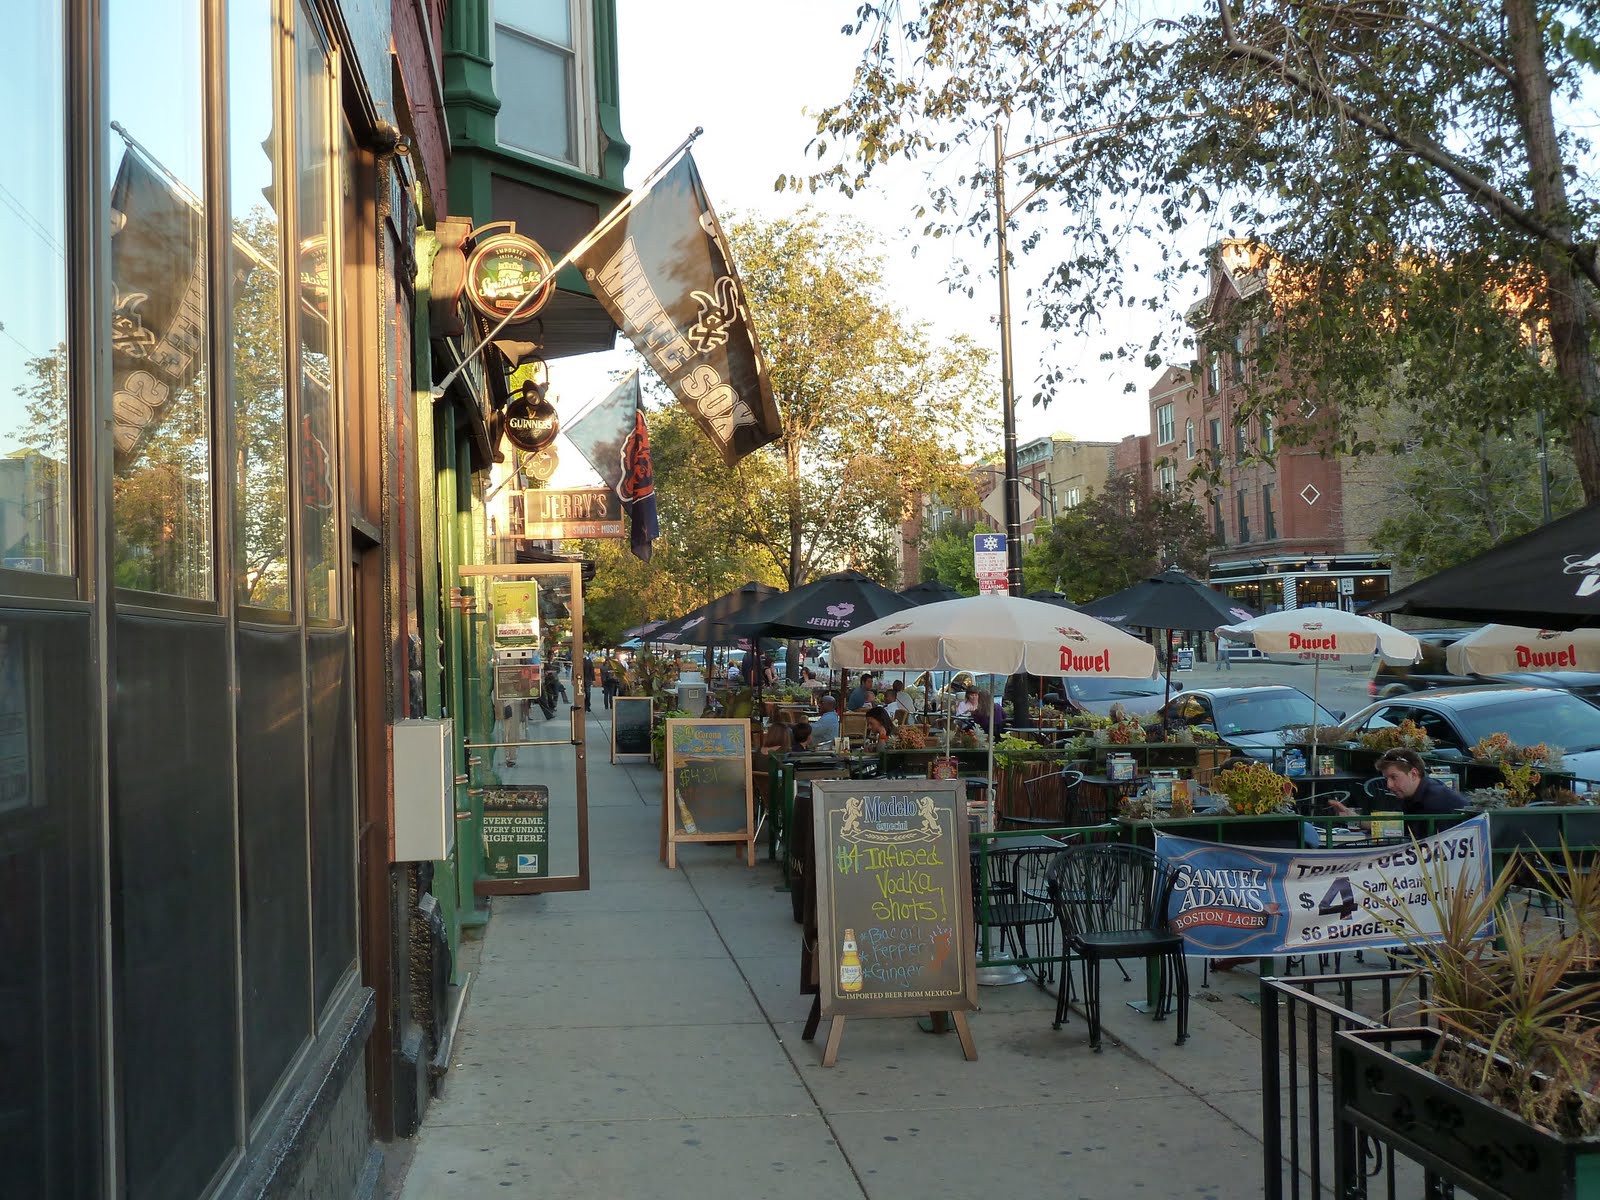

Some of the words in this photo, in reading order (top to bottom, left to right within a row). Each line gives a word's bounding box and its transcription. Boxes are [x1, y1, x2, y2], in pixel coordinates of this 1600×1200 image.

[495, 248, 527, 257] IMPORTED
[478, 271, 542, 297] Smithwick's
[596, 235, 698, 373] WHITE
[680, 364, 759, 443] SOX
[509, 417, 553, 430] GUINNESS
[540, 493, 608, 519] JERRY'S
[601, 523, 620, 534] MUSIC
[806, 617, 851, 628] JERRY'S
[1288, 632, 1337, 650] Duvel
[862, 640, 906, 665] Duvel
[1058, 645, 1111, 673] Duvel
[1514, 644, 1577, 668] Duvel
[694, 730, 722, 740] Corona
[863, 795, 918, 823] Modelo
[483, 816, 513, 825] EVERY
[514, 816, 546, 825] GAME.
[876, 820, 909, 832] especial
[483, 834, 515, 842] RIGHT
[516, 834, 546, 842] HERE.
[863, 843, 944, 870] Infused
[876, 868, 940, 899] Vodka
[1173, 864, 1267, 891] SAMUEL
[1362, 880, 1388, 893] Sam
[871, 887, 948, 922] shots!
[1178, 888, 1265, 914] ADAMS
[1299, 891, 1316, 911] $
[1318, 876, 1359, 921] 4
[1408, 891, 1440, 906] Lagr
[1175, 911, 1224, 929] BOSTON
[1226, 915, 1265, 926] LAGER
[1301, 926, 1322, 942] $6
[846, 992, 884, 1000] IMPORTED
[884, 991, 903, 999] BEER
[903, 990, 924, 998] FROM
[924, 989, 953, 998] MEXICO
